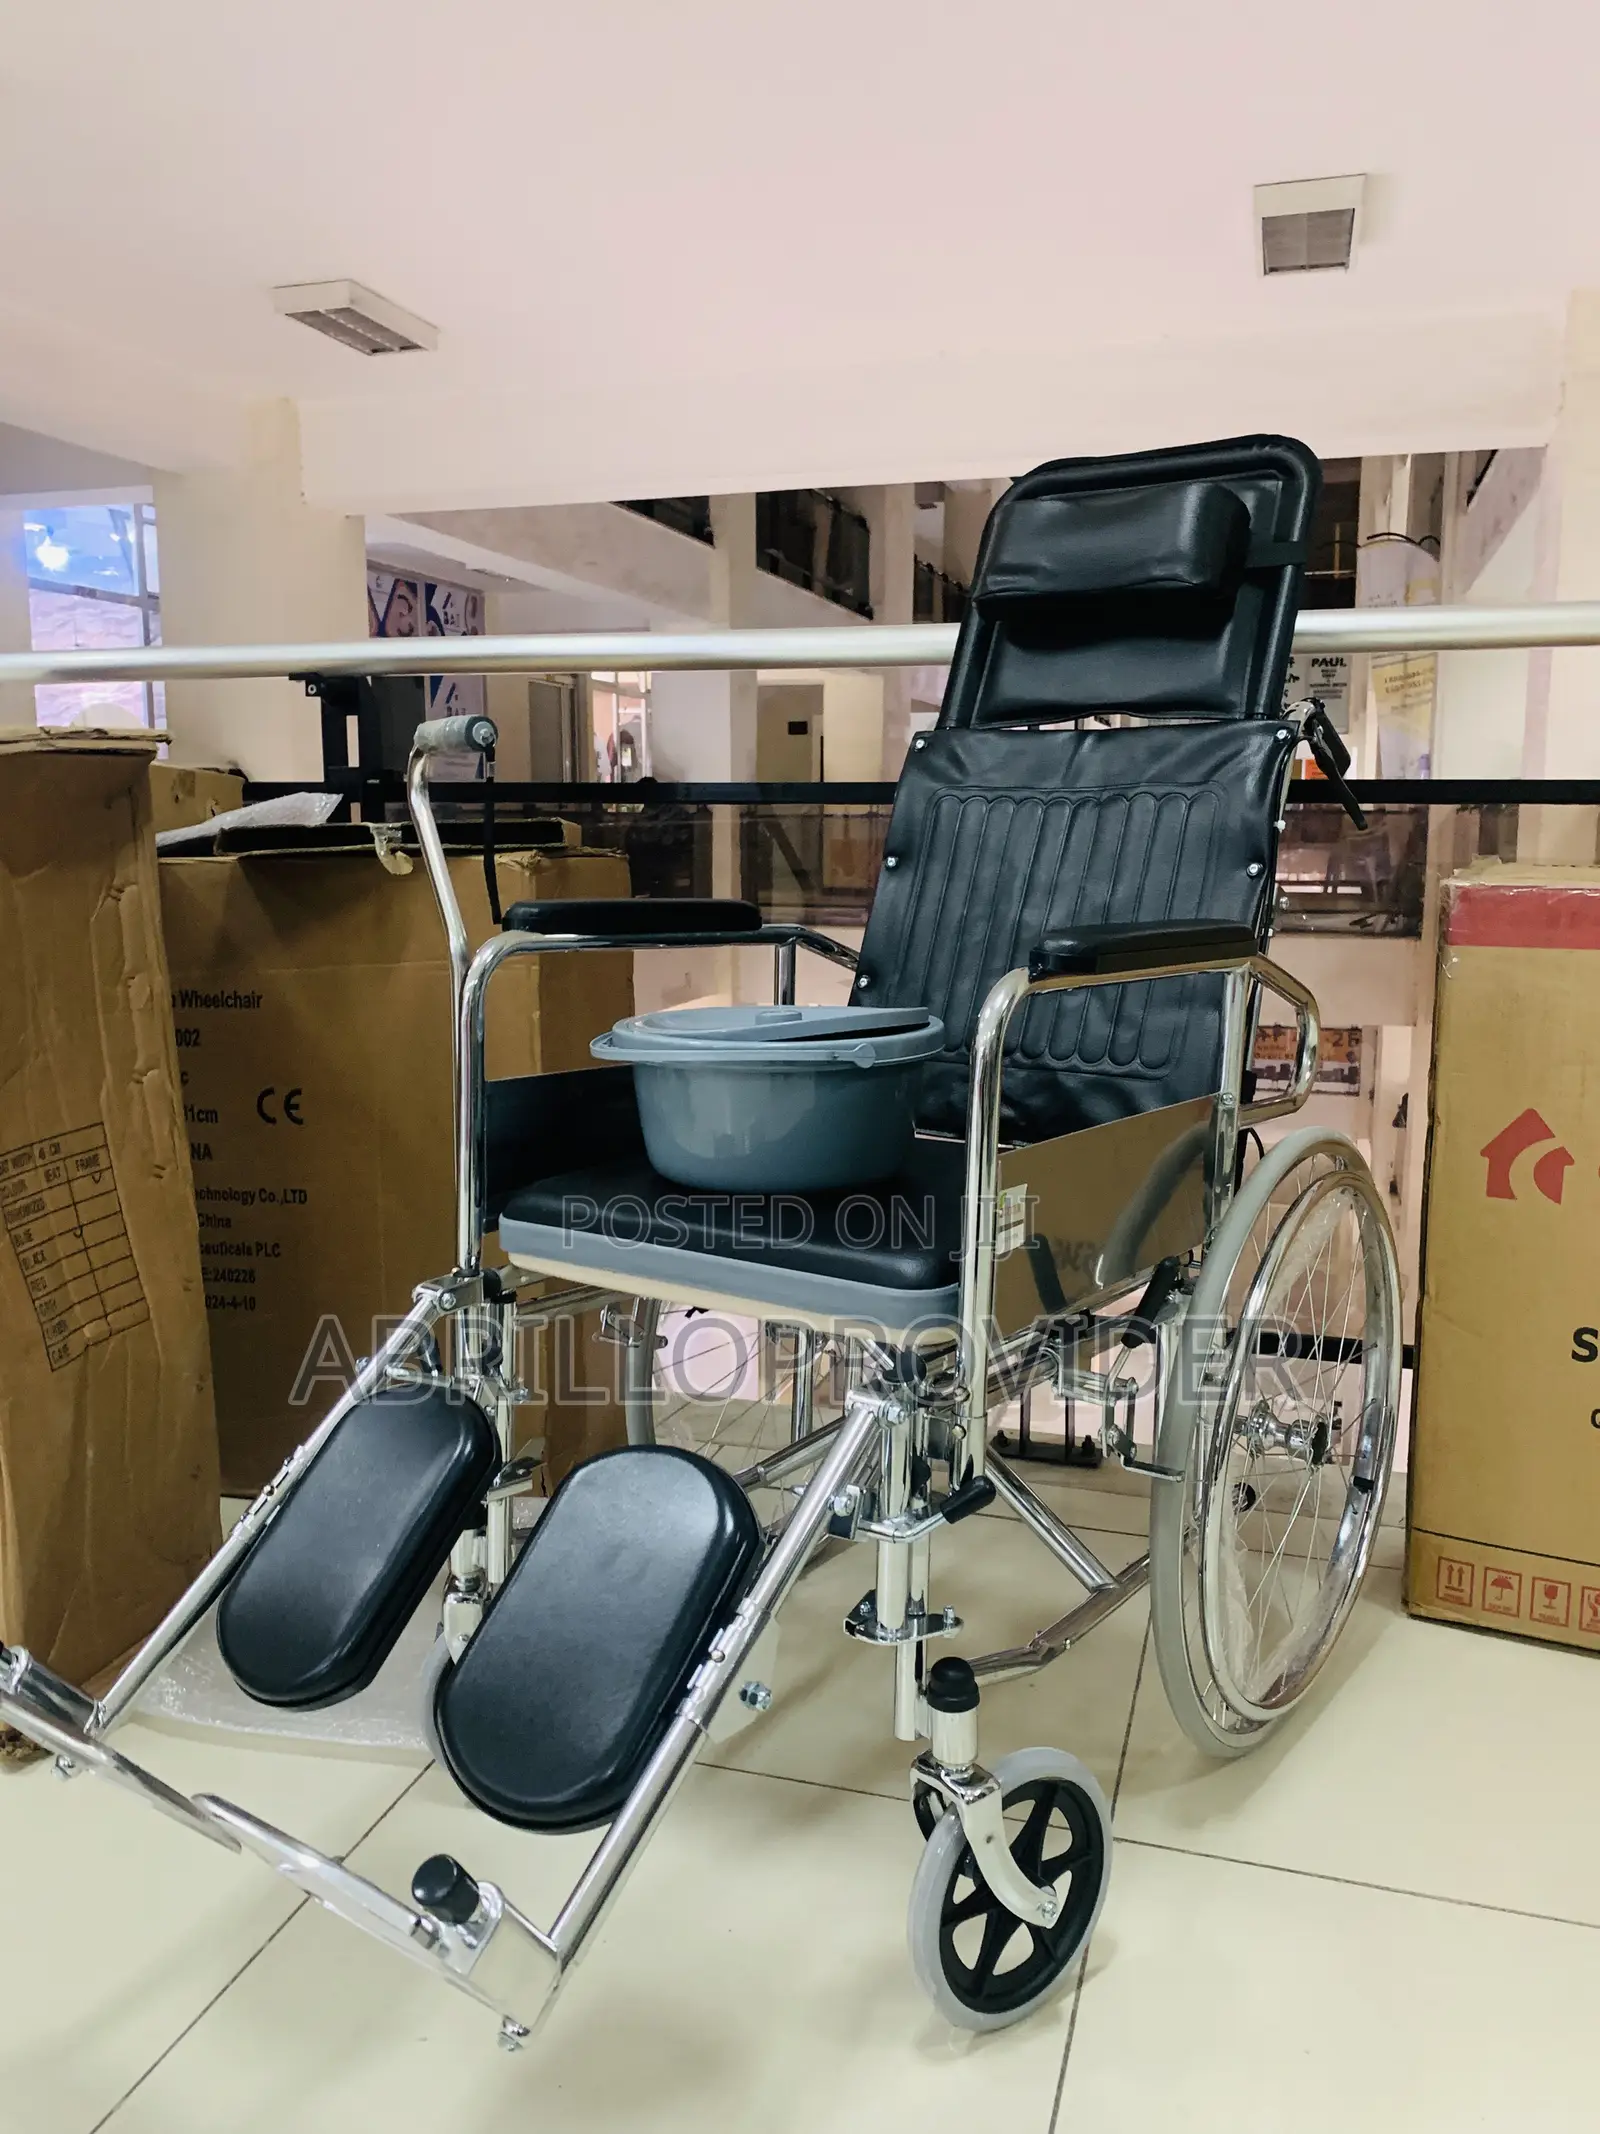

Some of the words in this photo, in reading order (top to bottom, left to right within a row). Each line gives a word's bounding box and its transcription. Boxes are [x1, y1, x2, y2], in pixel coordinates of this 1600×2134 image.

[1311, 657, 1347, 668] PAUL
[180, 989, 263, 1010] Wheelchair
[257, 1087, 304, 1125] CE
[198, 1213, 232, 1229] China
[255, 1242, 281, 1259] PLC
